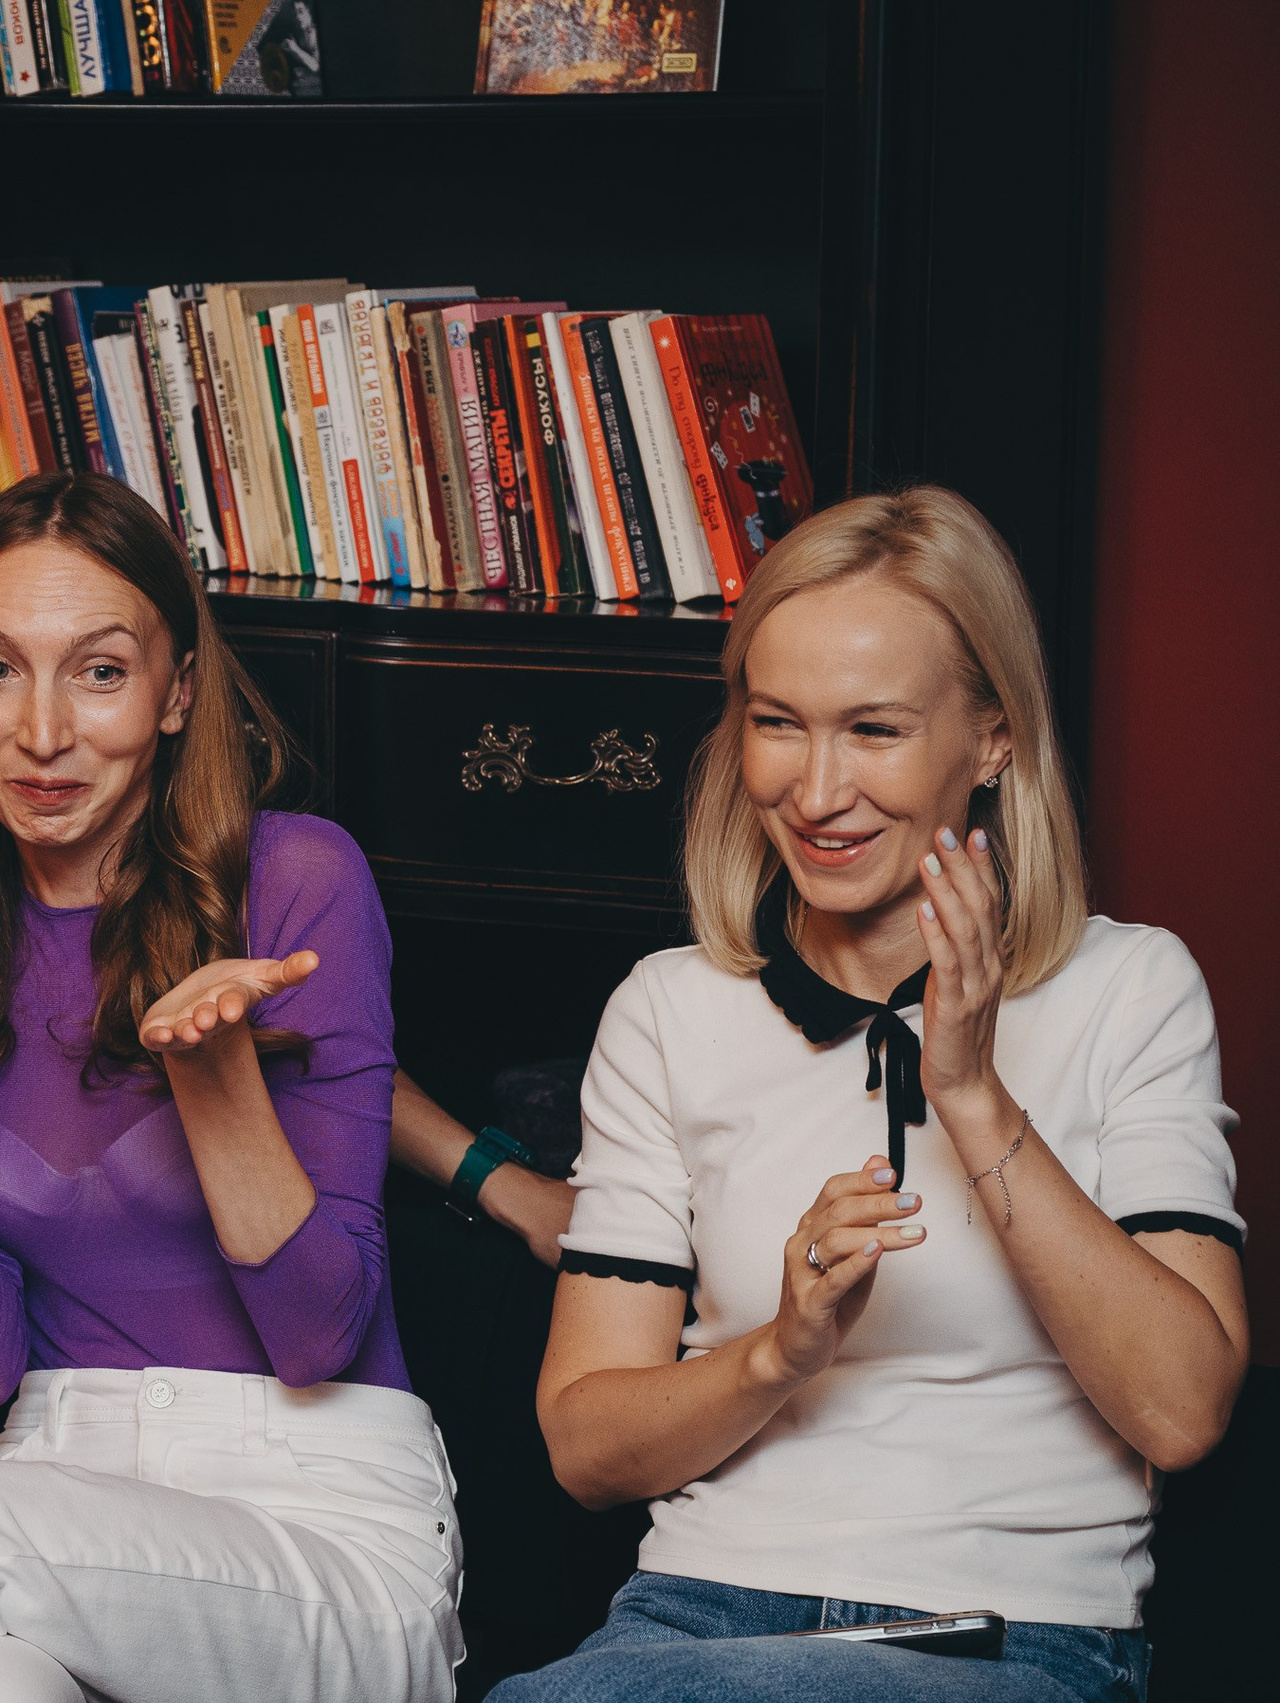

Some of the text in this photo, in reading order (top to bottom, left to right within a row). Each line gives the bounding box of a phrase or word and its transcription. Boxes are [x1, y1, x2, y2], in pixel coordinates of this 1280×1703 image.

[65, 342, 98, 443] МАГИЯ ЧИСЕЛ
[305, 342, 323, 394] ПЕРЕЛЬМАН
[349, 299, 392, 474] ФОКУСОВ И ТРЮКОВ
[531, 356, 555, 445] ФОКУСЫ
[322, 433, 335, 476] Научные
[460, 398, 486, 473] МАГИЯ
[489, 408, 516, 488] СЕКРЕТЫ
[678, 415, 702, 470] сторону
[695, 472, 722, 532] фокуса
[578, 371, 633, 592] Записки на полях шляпы фокусника
[473, 480, 503, 579] ЧЕСТНАЯ
[510, 514, 520, 551] РОМАНОВ
[634, 539, 647, 569] МАГОВ
[641, 571, 650, 583] ОТ
